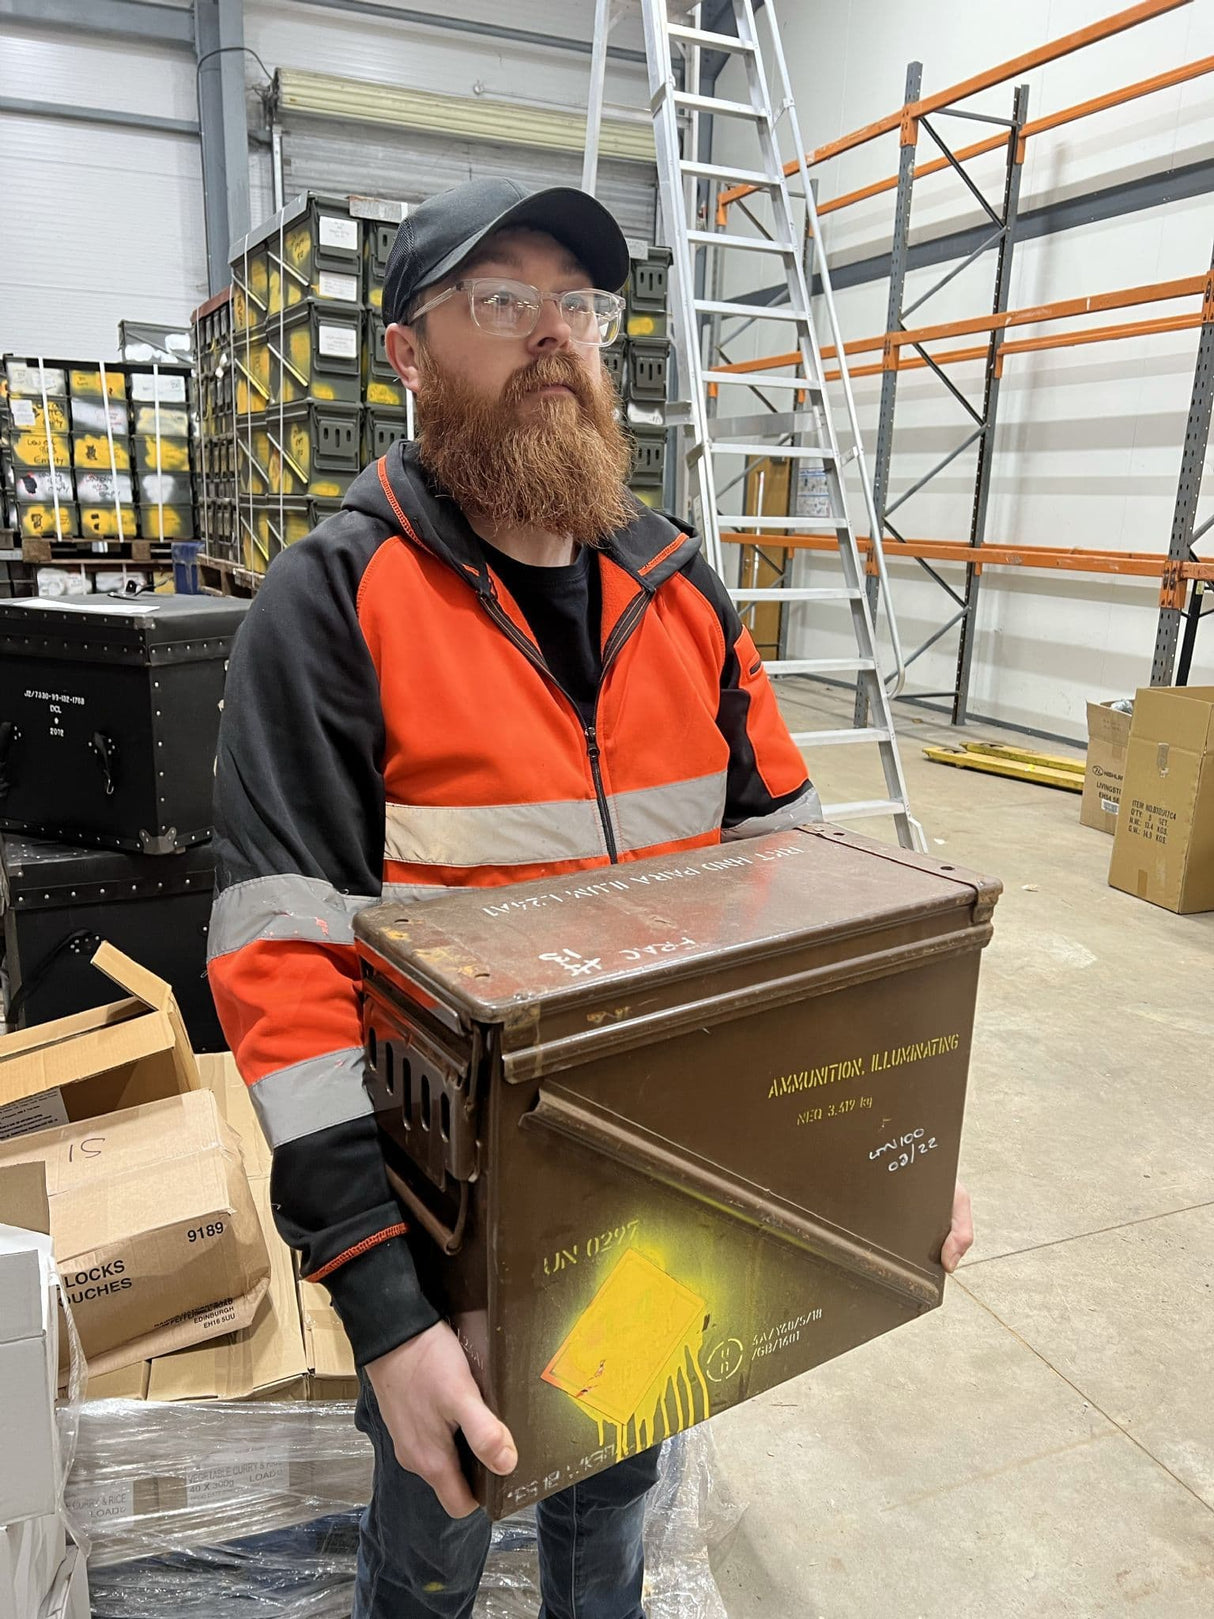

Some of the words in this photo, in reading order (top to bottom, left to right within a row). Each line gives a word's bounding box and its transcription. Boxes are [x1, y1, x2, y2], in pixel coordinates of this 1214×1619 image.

[701, 856, 753, 871] HND
[755, 846, 805, 861] RKT
[629, 866, 701, 885] PARA
[618, 936, 697, 960] FRAC
[871, 1033, 960, 1073] ILLUMINATING
[796, 1108, 823, 1126] NEQ
[859, 1096, 873, 1109] kg
[187, 1221, 224, 1243] 9189
[543, 1244, 577, 1275] UN
[586, 1219, 639, 1257] 0297
[193, 1306, 235, 1324] EDINBURGH
[108, 1493, 127, 1506] RICE
